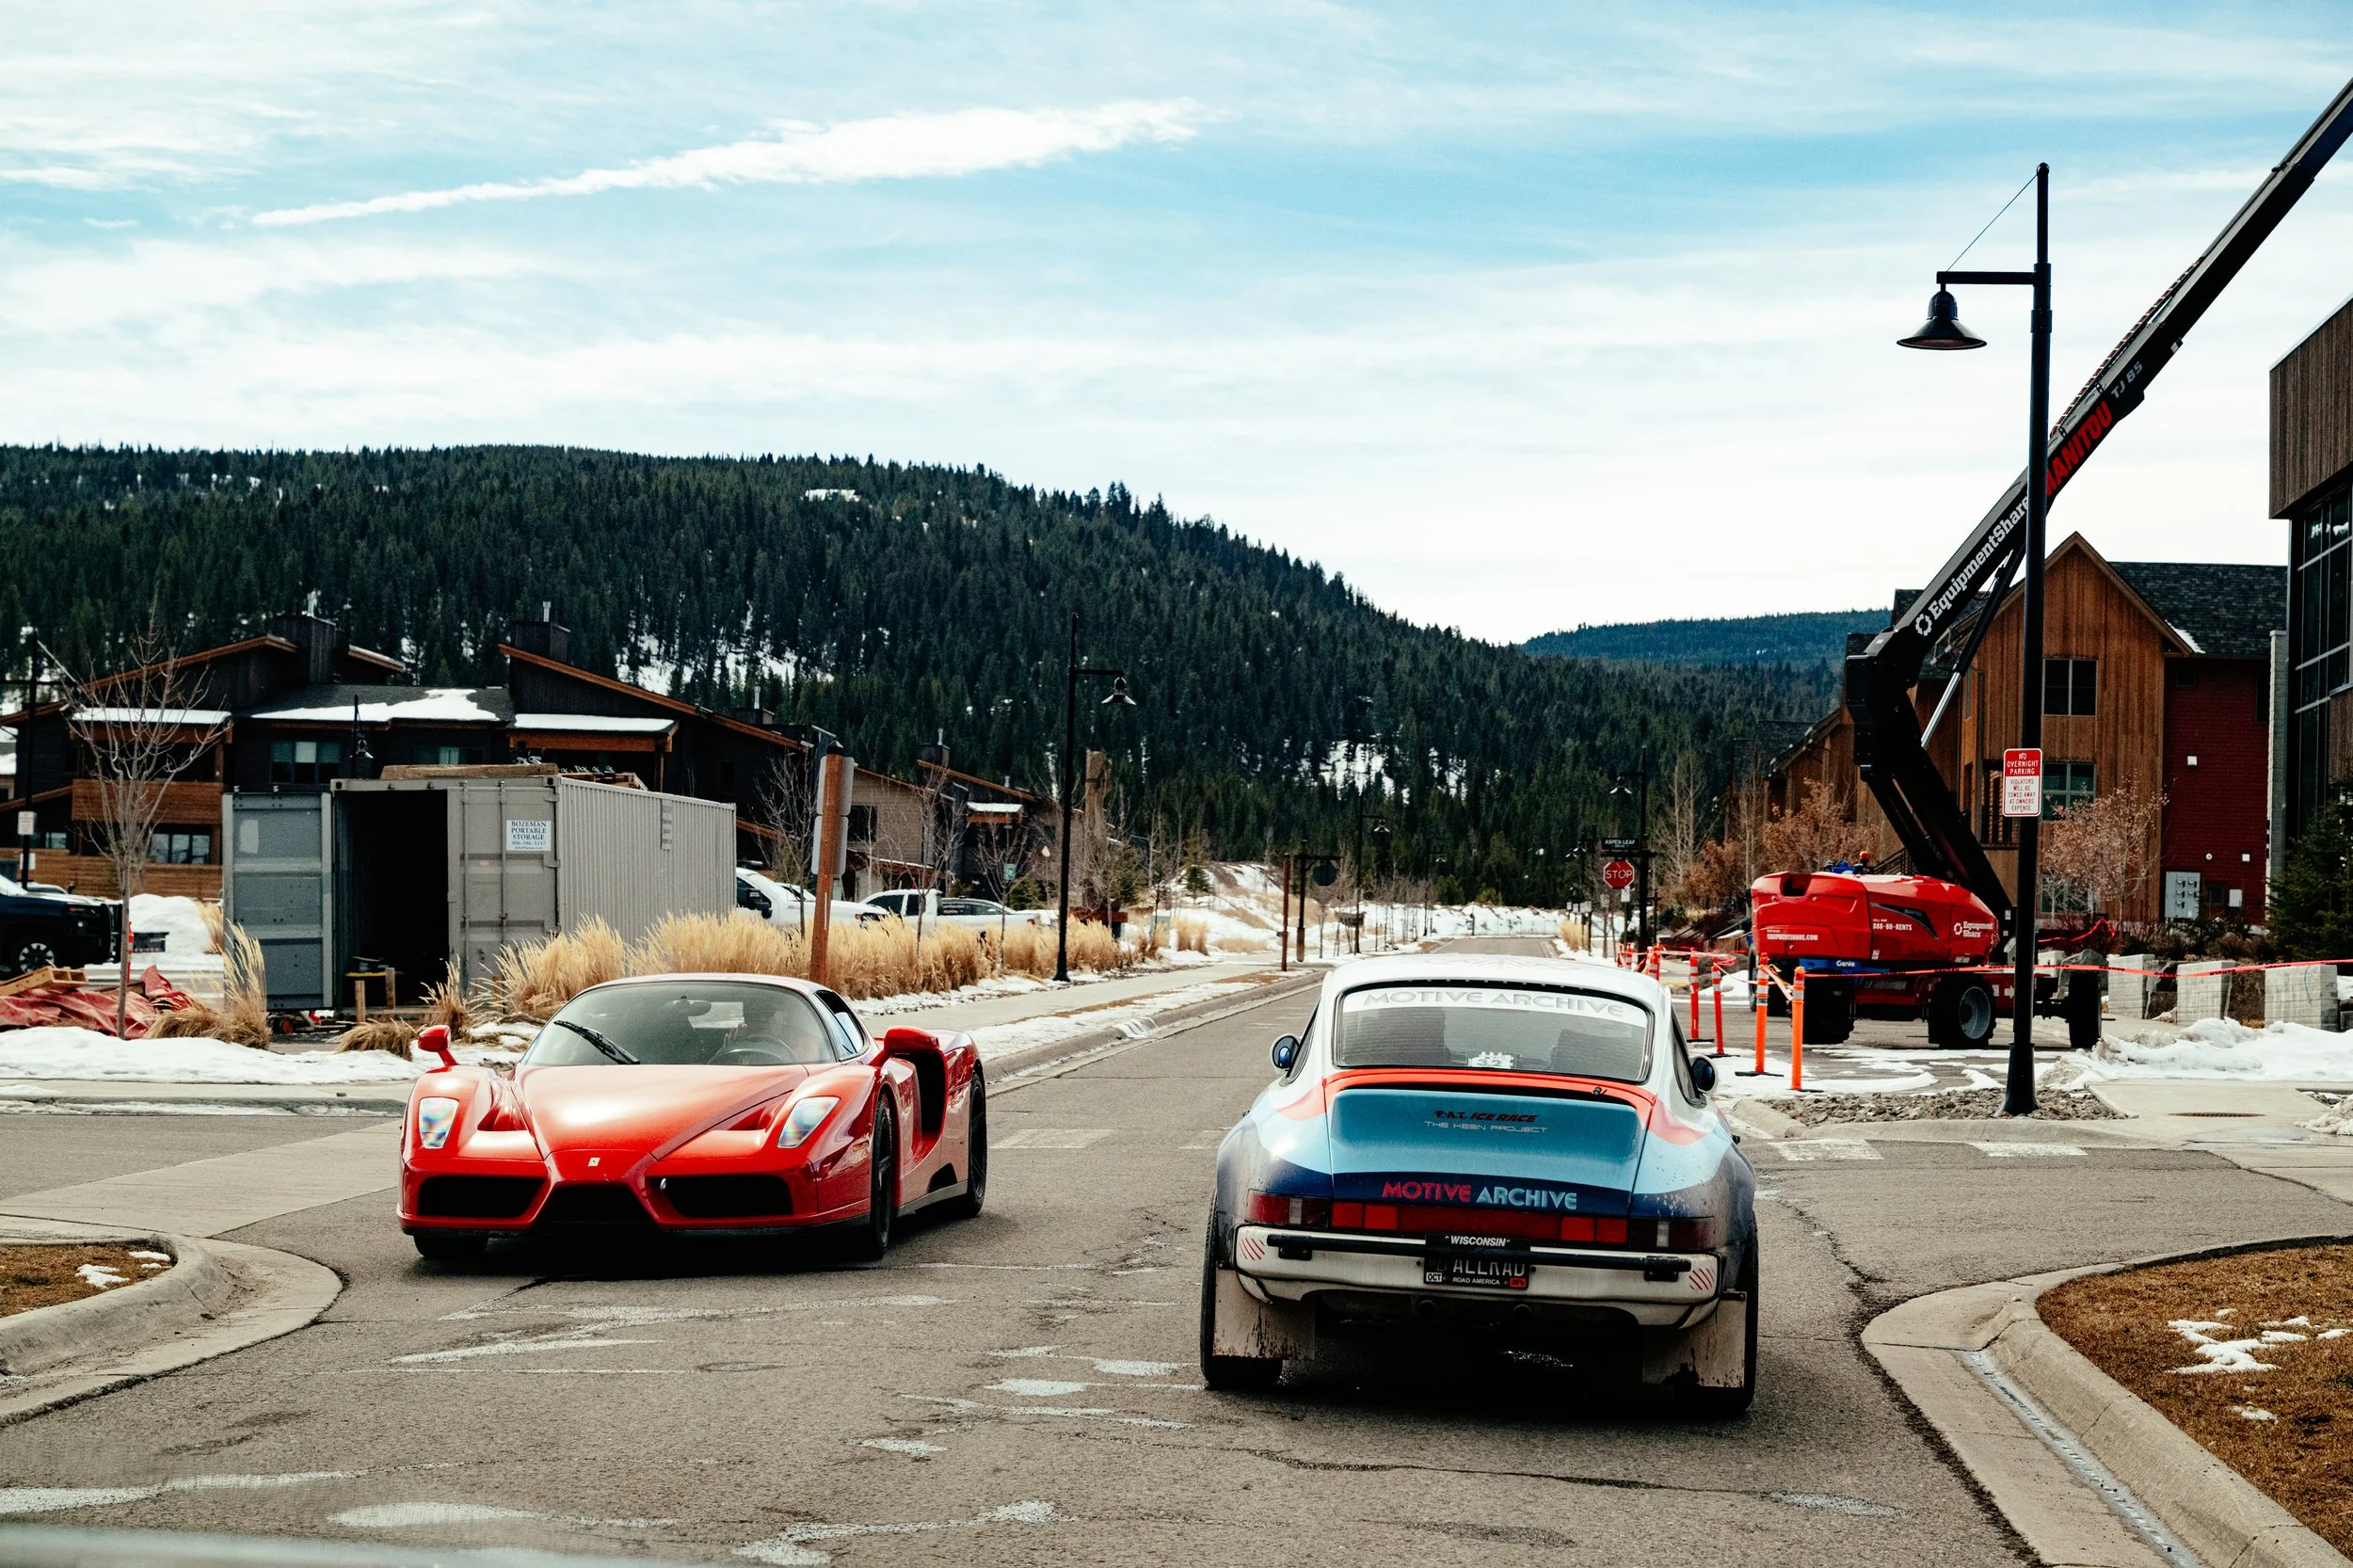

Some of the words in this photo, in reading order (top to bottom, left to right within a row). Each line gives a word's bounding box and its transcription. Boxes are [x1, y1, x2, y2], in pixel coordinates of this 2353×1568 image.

[2110, 380, 2125, 398] TJ
[2126, 361, 2143, 383] 85
[1928, 496, 2028, 620] EquipmentShare
[2007, 760, 2039, 768] OVERNIGHT
[2009, 767, 2035, 776] PARKING
[1606, 870, 1633, 879] STOP
[1963, 920, 1993, 931] Equipment
[1364, 991, 1482, 1006] MOTIVE
[1491, 993, 1624, 1017] ARCHIVE
[1469, 1112, 1497, 1121] ICE
[1496, 1113, 1539, 1123] RACE
[1424, 1120, 1449, 1128] THE
[1490, 1125, 1548, 1133] PROJECT
[1382, 1181, 1472, 1203] MOTIVE
[1476, 1186, 1577, 1210] ARCHIVE
[1450, 1235, 1507, 1247] WISCONSIN
[1427, 1272, 1442, 1282] OCT
[1471, 1277, 1500, 1286] AMERICA
